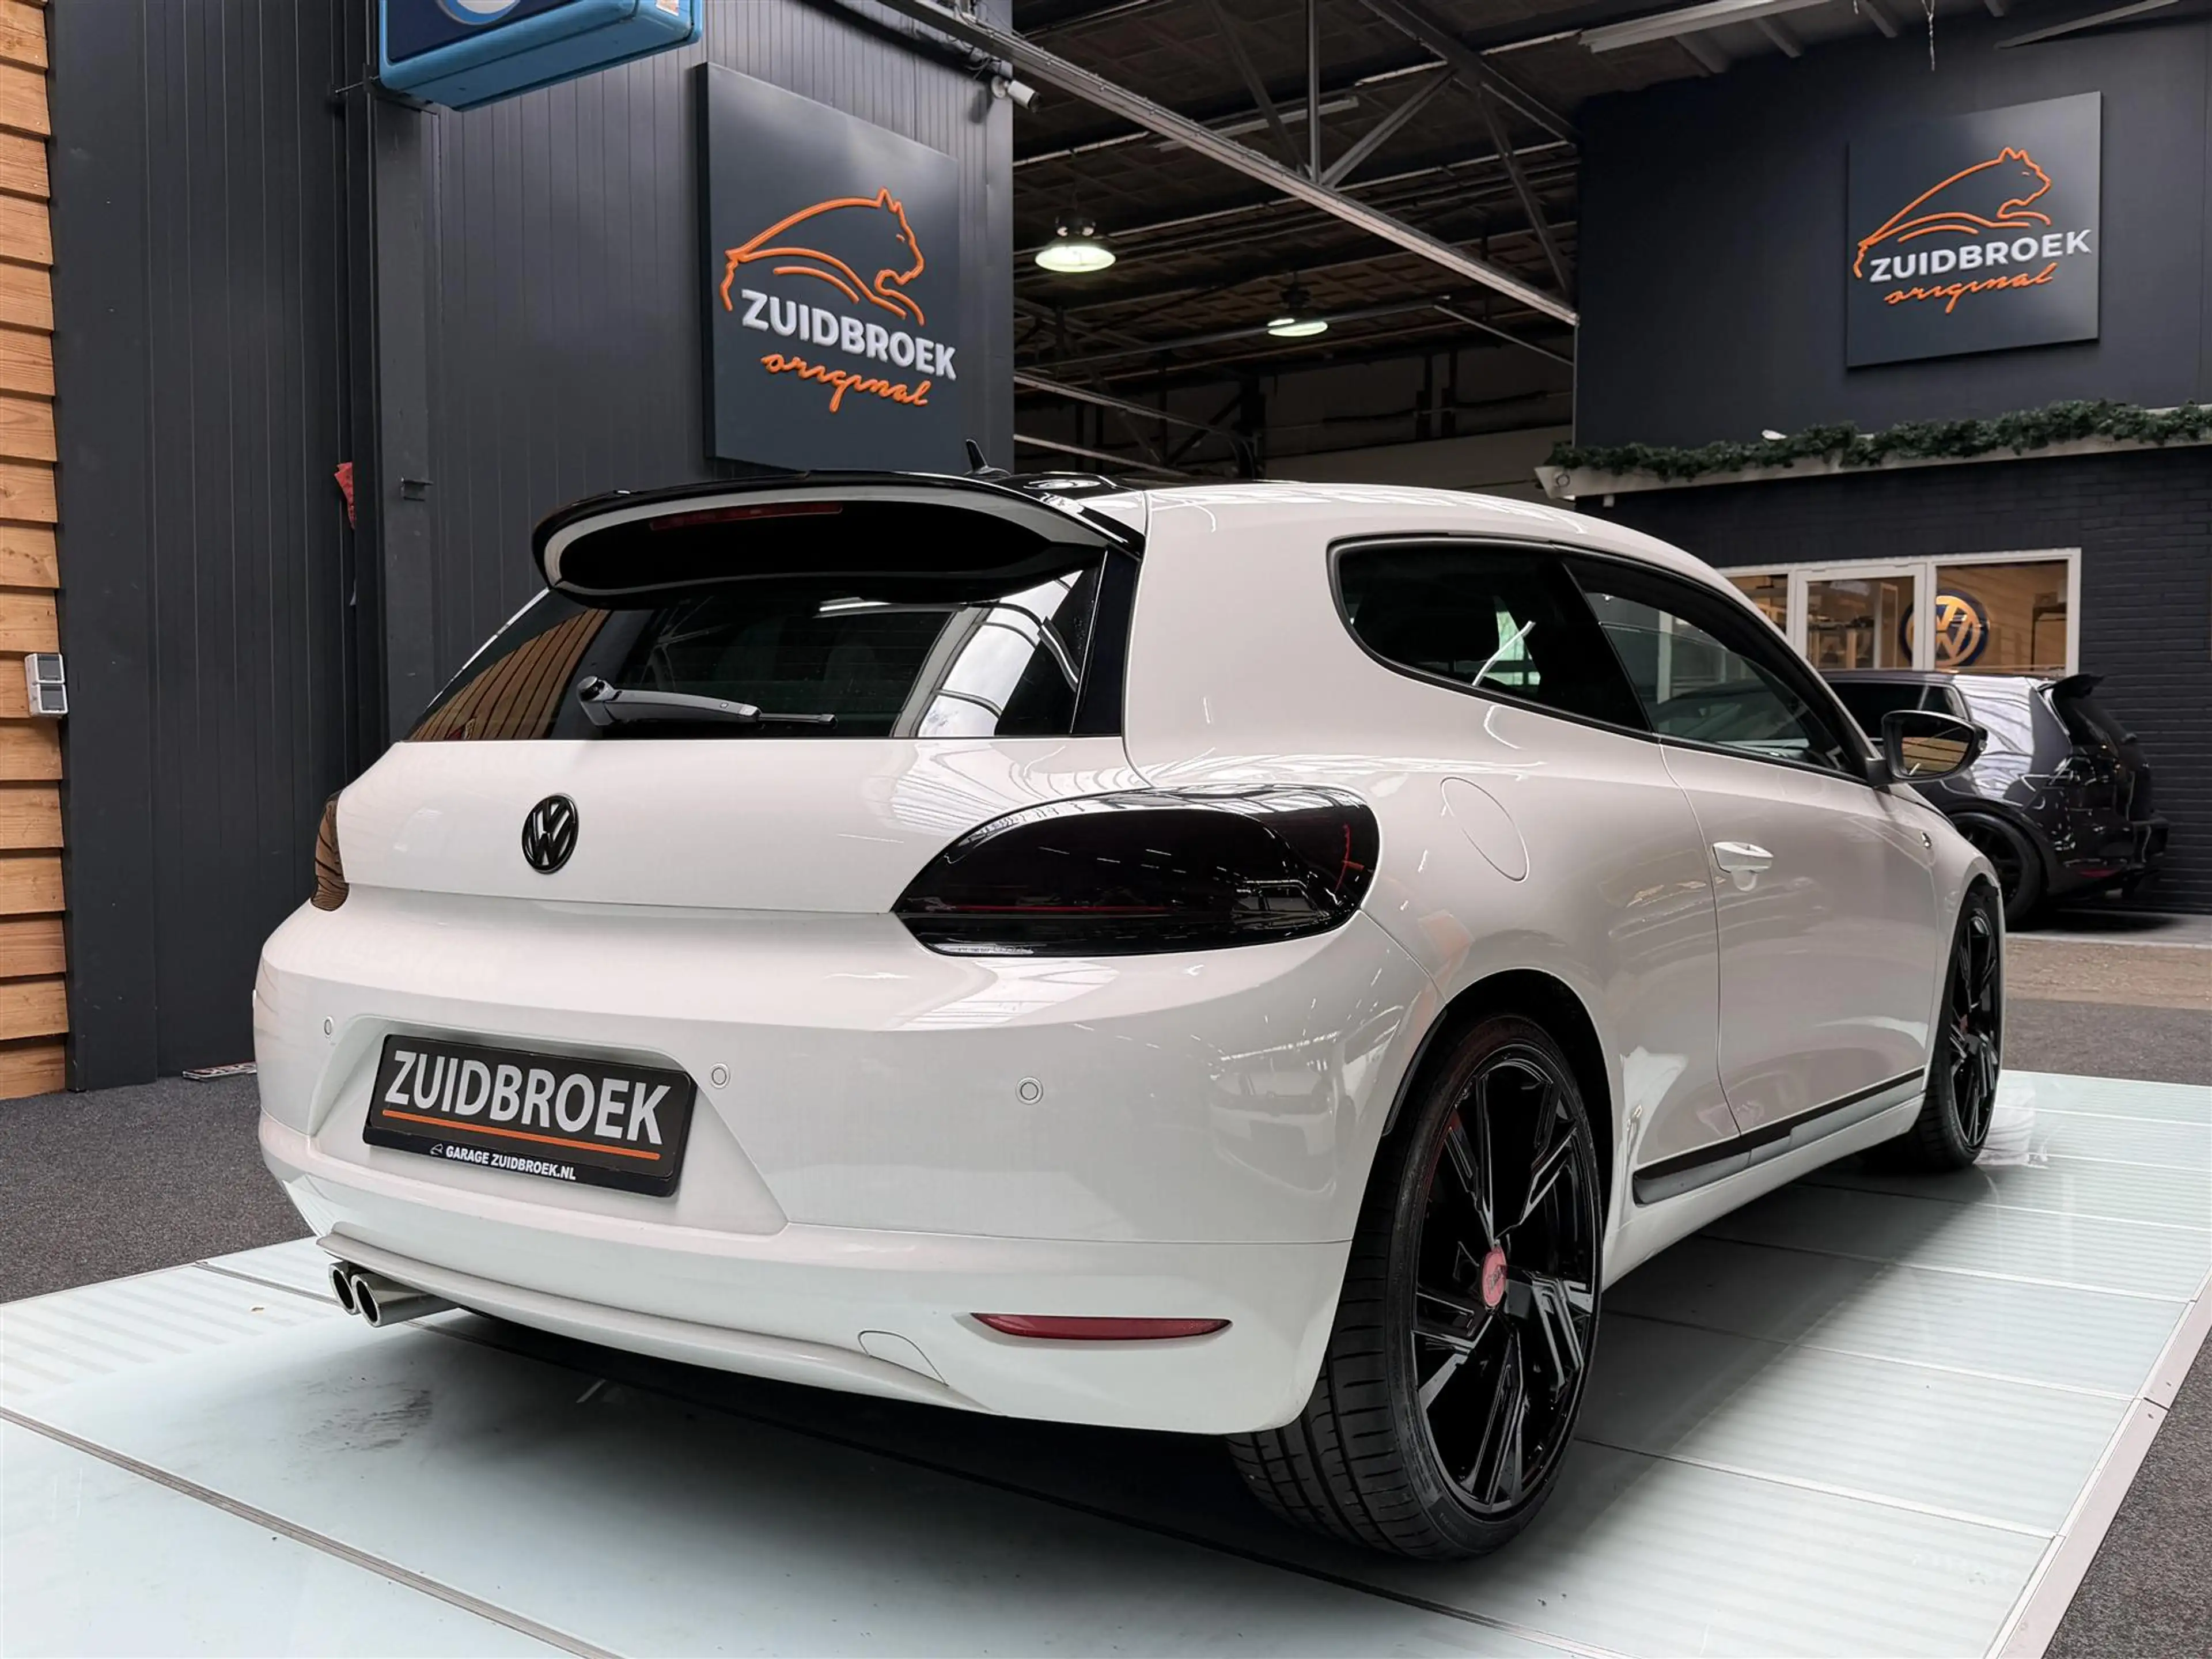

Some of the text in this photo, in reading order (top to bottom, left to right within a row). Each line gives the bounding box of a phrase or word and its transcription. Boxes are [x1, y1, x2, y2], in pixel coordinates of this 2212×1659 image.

[1869, 229, 2093, 283] ZUIDBROEK
[1883, 262, 2058, 315] original
[741, 289, 957, 381] ZUIDBROEK
[760, 353, 931, 414] original
[384, 1050, 672, 1145] ZUIDBROEK
[445, 1145, 577, 1180] GARAGE ZUIDBROEK.NL
